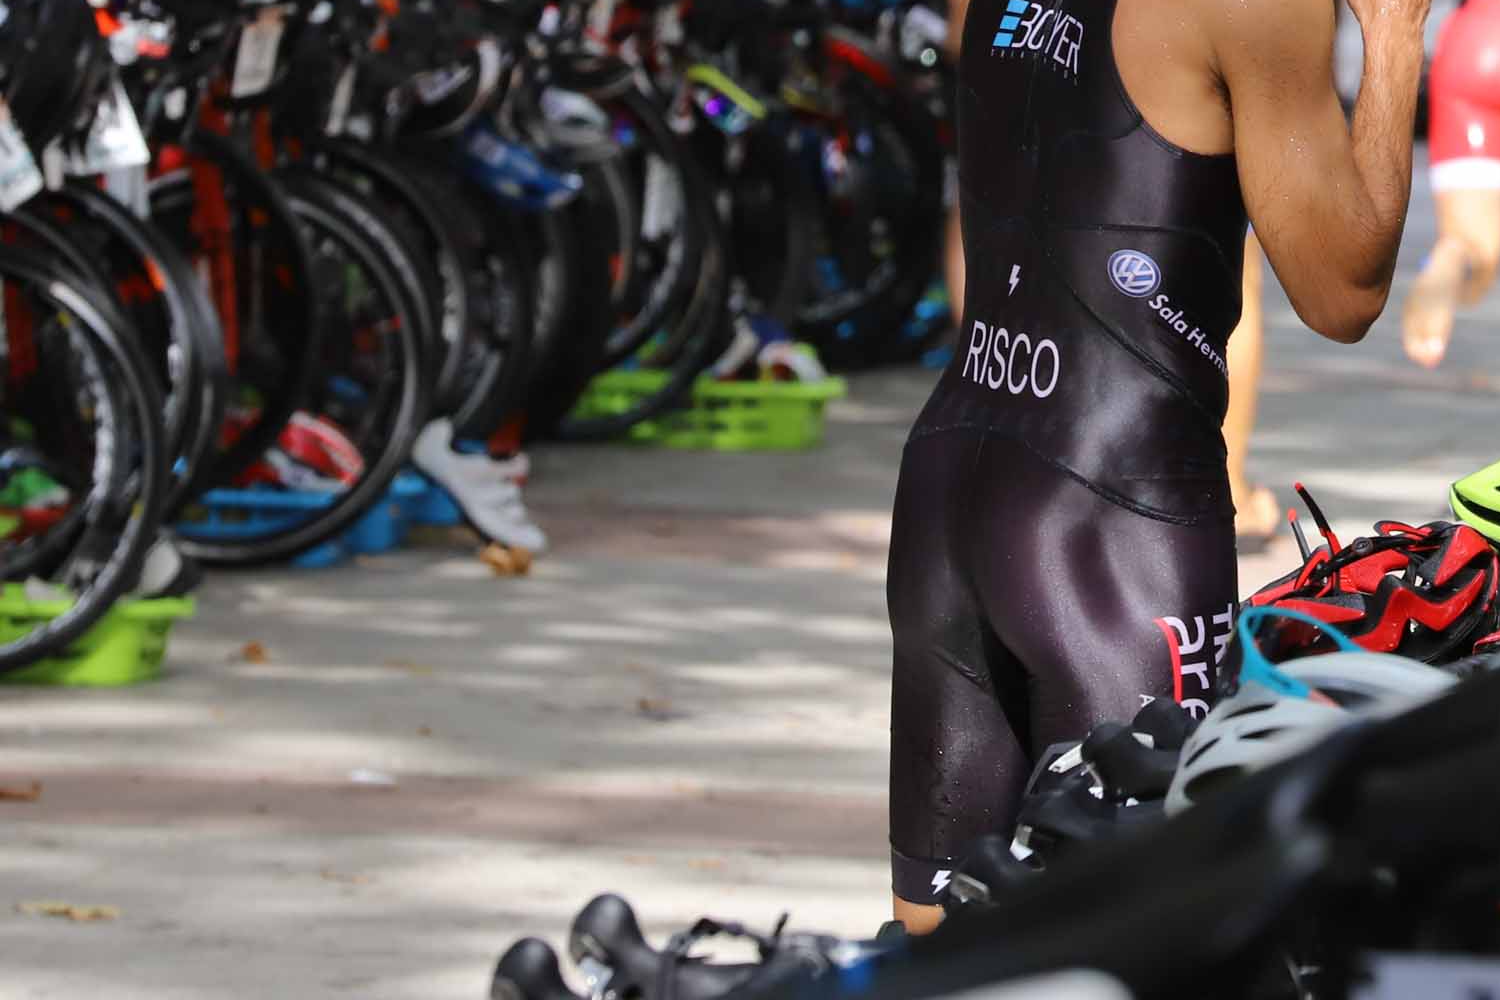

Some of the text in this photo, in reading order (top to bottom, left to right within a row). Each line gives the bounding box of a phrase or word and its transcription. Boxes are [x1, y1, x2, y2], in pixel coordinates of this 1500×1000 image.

[962, 320, 1060, 398] RISCO
[1148, 294, 1229, 378] Sala Herm
[1161, 616, 1210, 720] are
